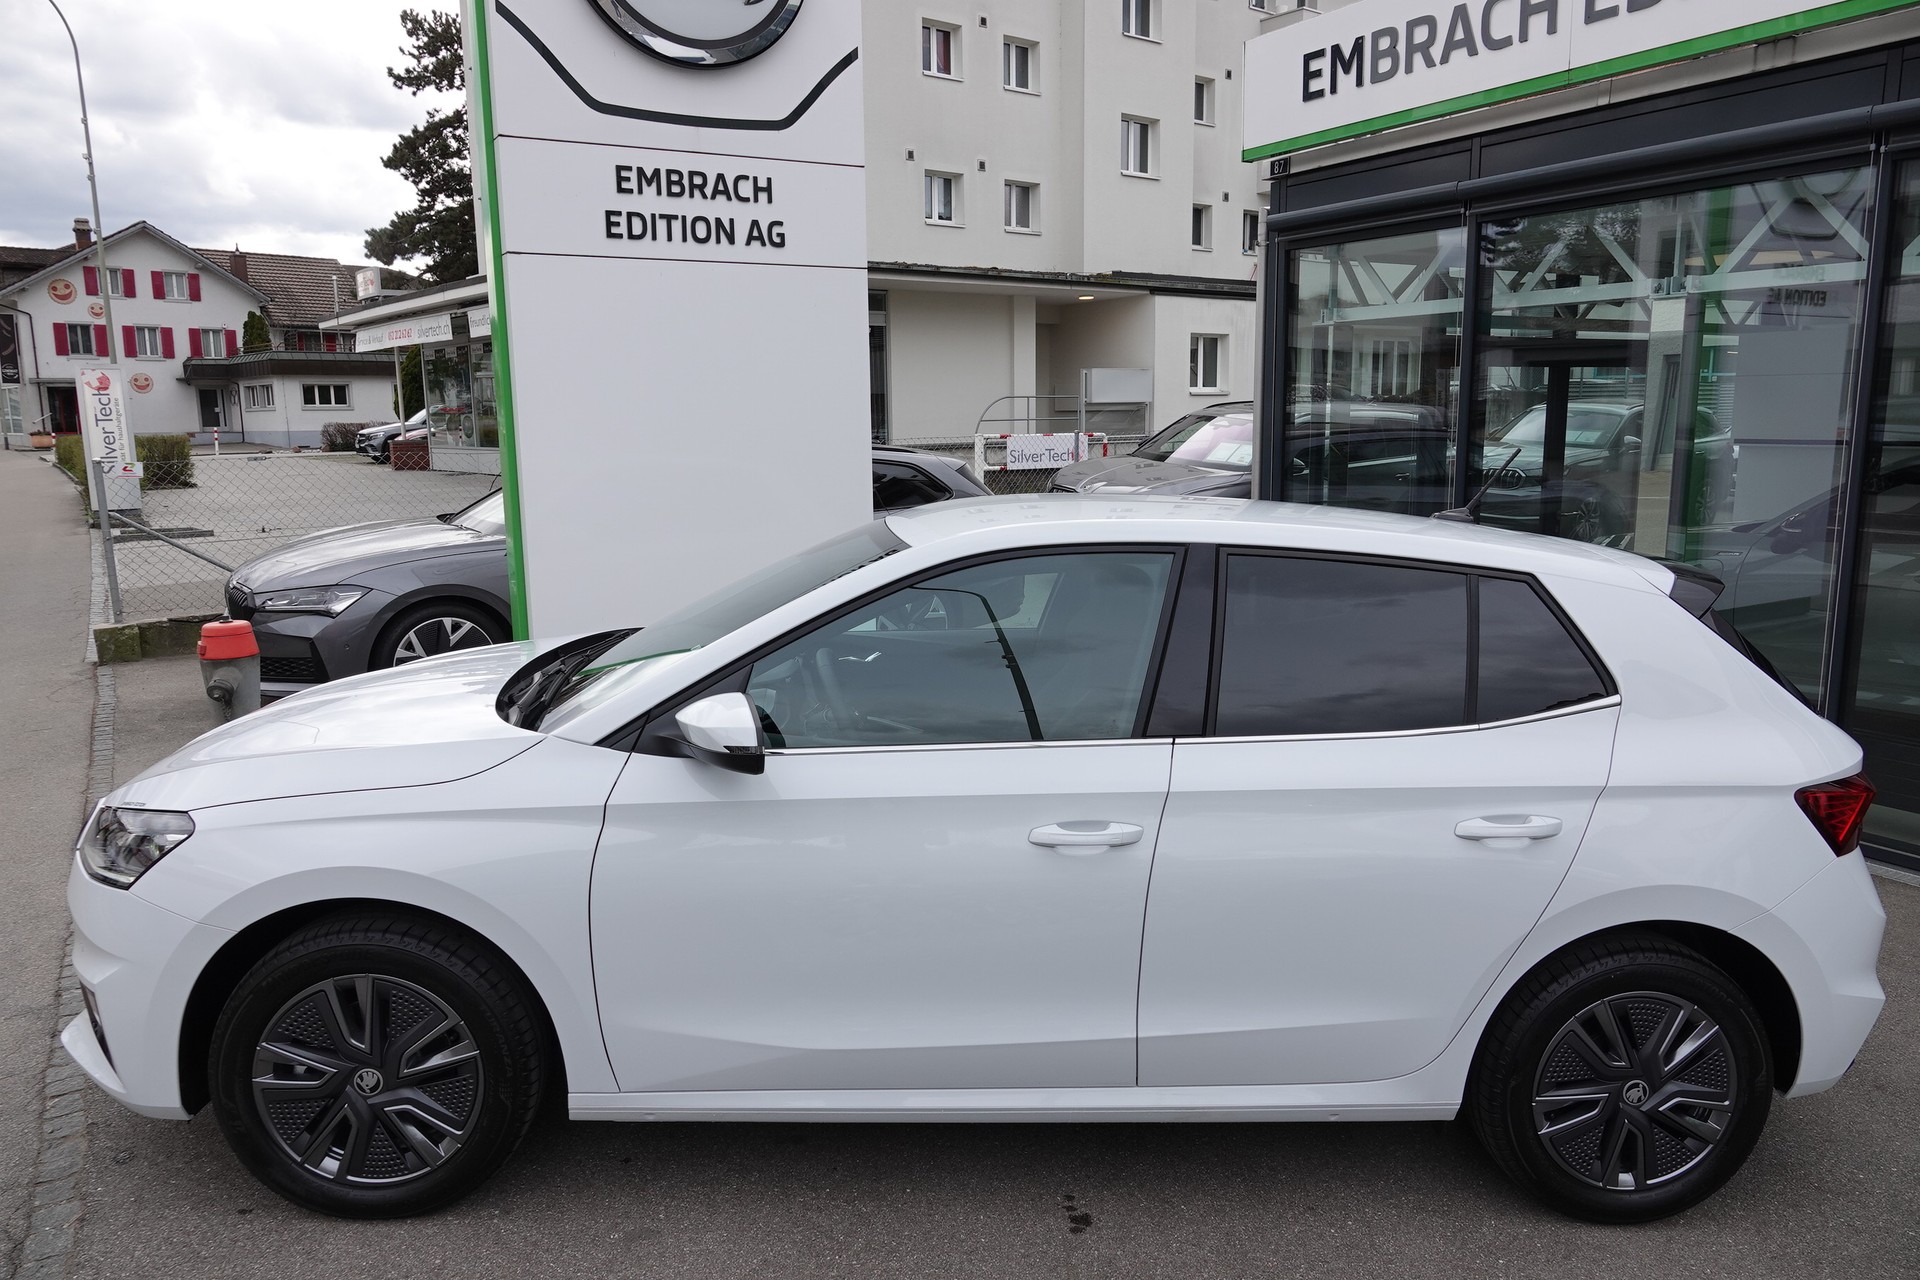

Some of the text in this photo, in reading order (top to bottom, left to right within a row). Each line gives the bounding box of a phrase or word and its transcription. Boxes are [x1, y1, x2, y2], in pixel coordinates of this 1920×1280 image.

[1302, 0, 1559, 102] EMBRACH
[615, 164, 773, 204] EMBRACH
[1274, 160, 1284, 174] 87
[605, 210, 786, 248] EDITION AG
[417, 321, 450, 339] silvertech.ch
